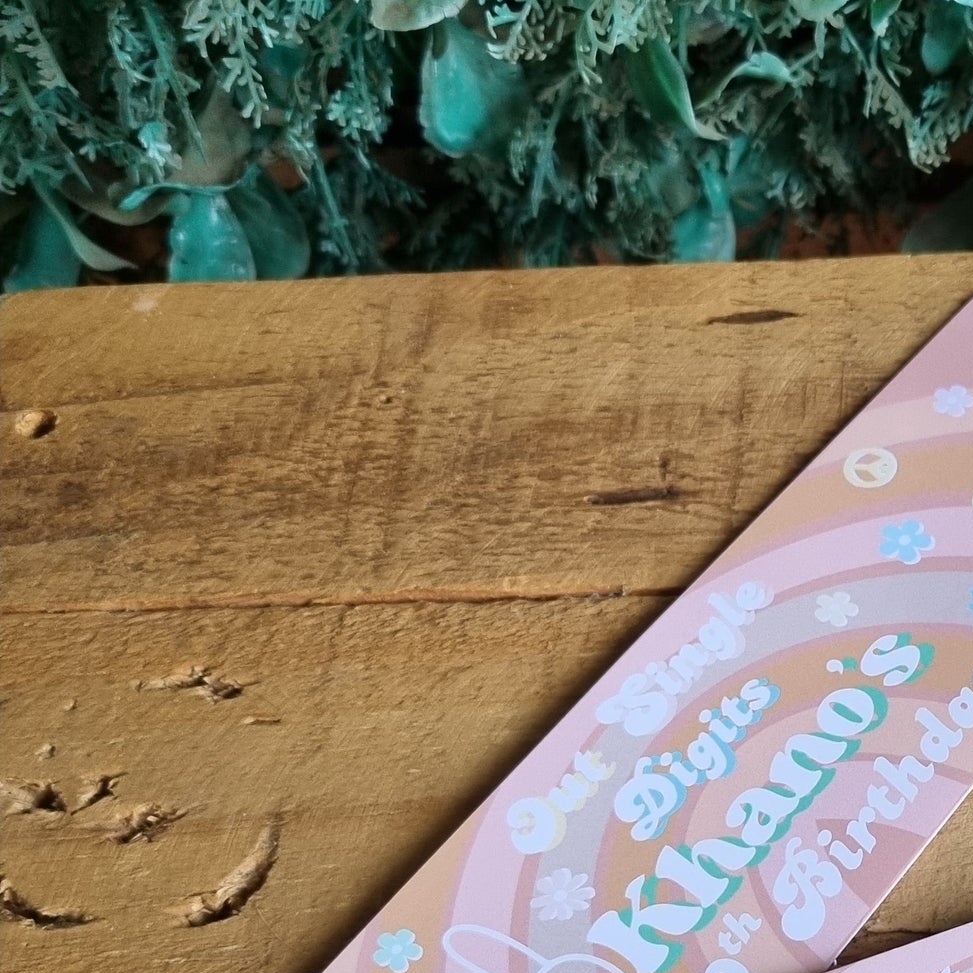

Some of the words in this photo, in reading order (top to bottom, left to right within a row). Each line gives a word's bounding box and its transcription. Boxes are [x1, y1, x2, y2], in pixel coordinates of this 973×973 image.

[507, 750, 616, 854] Out
[596, 581, 775, 737] Single
[614, 678, 780, 842] Digits
